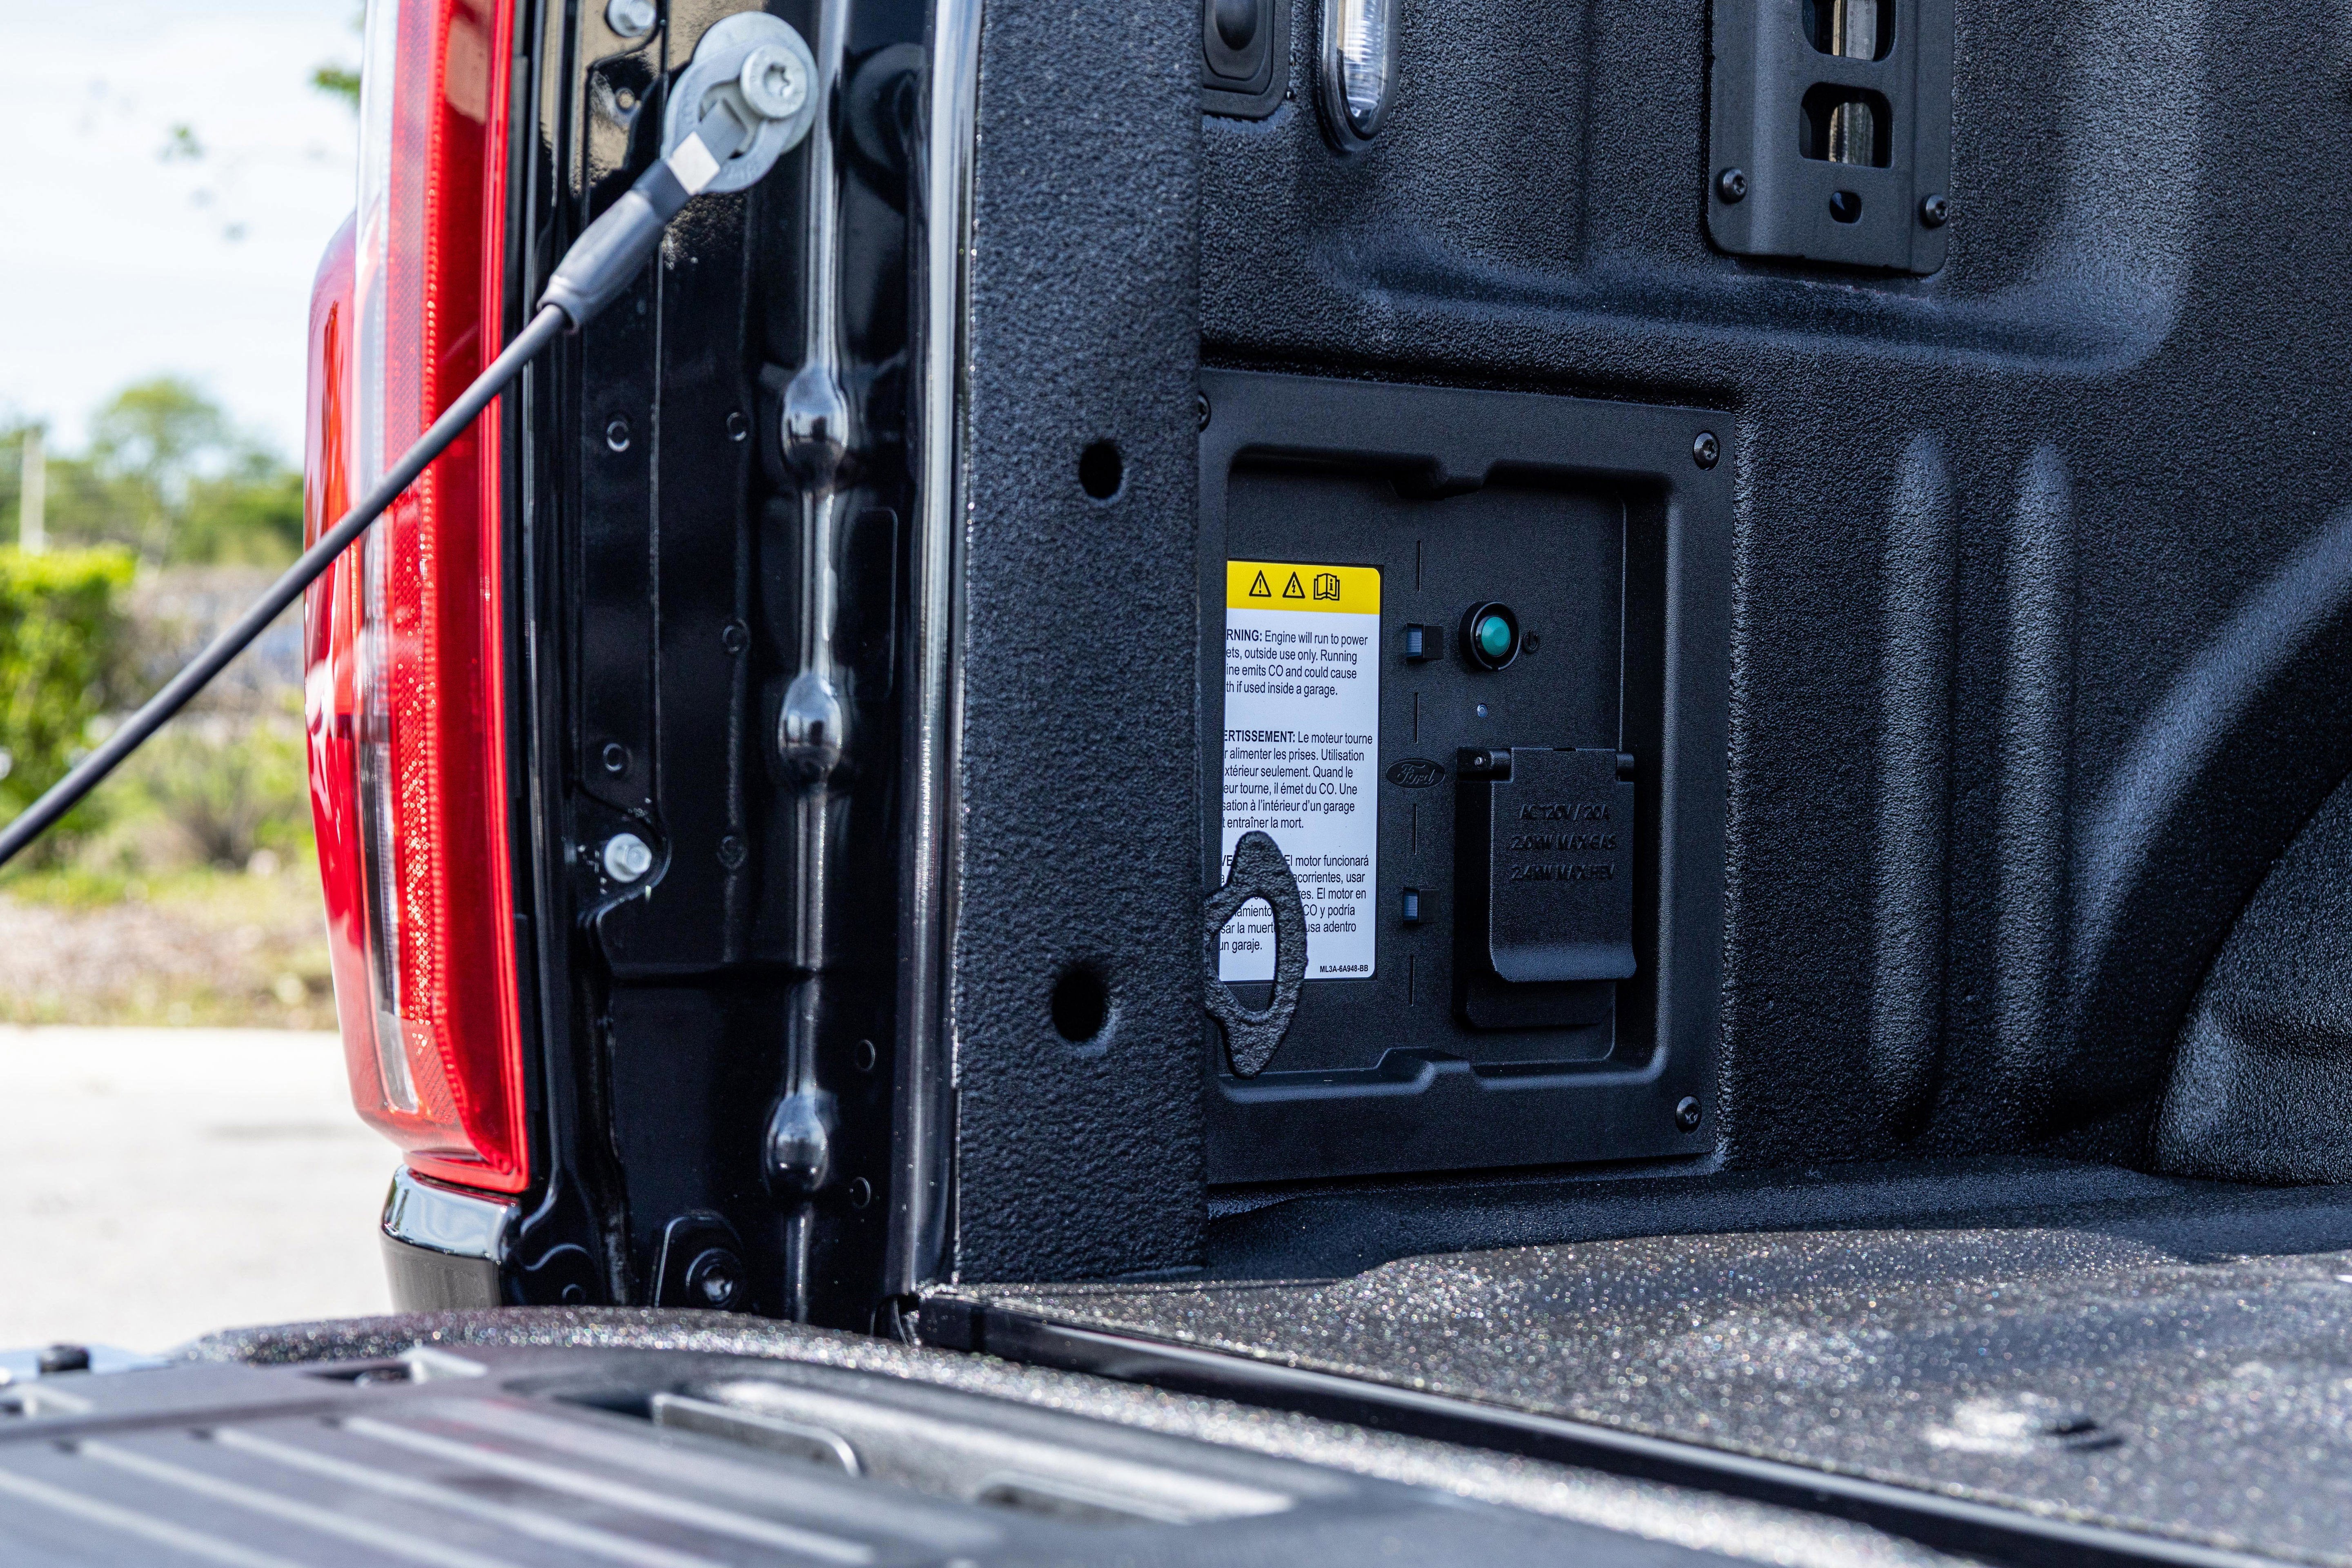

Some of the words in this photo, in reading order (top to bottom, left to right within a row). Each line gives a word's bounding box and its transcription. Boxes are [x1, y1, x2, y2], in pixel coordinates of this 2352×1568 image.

[1226, 629, 1262, 641] RNING:
[1265, 630, 1296, 646] Engine
[1298, 632, 1312, 644] will
[1314, 635, 1328, 644] run
[1331, 633, 1339, 645] to
[1341, 636, 1368, 648] power
[1226, 646, 1242, 660] ets,
[1244, 647, 1277, 659] outside
[1280, 650, 1296, 660] use
[1298, 649, 1318, 664] only.
[1321, 649, 1357, 665] Running
[1227, 663, 1240, 675] ine
[1242, 664, 1266, 676] emits
[1268, 664, 1283, 677] CO
[1285, 666, 1302, 677] and
[1304, 666, 1328, 678] could
[1330, 669, 1357, 679] cause
[1237, 681, 1243, 693] if
[1244, 682, 1265, 693] used
[1268, 682, 1294, 694] inside
[1296, 685, 1301, 695] a
[1304, 686, 1338, 698] garage.
[1225, 729, 1295, 743] ERTISSEMENT:
[1298, 731, 1309, 743] Le
[1311, 732, 1343, 744] moteur
[1345, 733, 1373, 744] tourne
[1229, 747, 1272, 760] alimenter
[1274, 748, 1286, 760] les
[1289, 748, 1318, 763] prises.
[1321, 748, 1364, 761] Utilisation
[1225, 764, 1259, 777] xtérieur
[1261, 765, 1311, 778] seulement.
[1313, 766, 1343, 778] Quand
[1345, 766, 1353, 778] le
[1397, 763, 1437, 784] Ford
[1223, 783, 1238, 794] eur
[1240, 782, 1271, 796] tourne,
[1274, 782, 1278, 794] il
[1281, 782, 1304, 794] émet
[1305, 782, 1316, 795] du
[1319, 782, 1337, 795] CO.
[1339, 783, 1357, 795] Une
[1223, 799, 1248, 811] sation
[1250, 799, 1256, 811] à
[1323, 802, 1355, 815] garage
[1519, 804, 1538, 820] AC
[1584, 804, 1610, 820] 20A
[1227, 816, 1269, 828] entraîner
[1271, 816, 1278, 829] la
[1281, 817, 1304, 829] mort.
[1556, 834, 1587, 850] MAX
[1296, 855, 1321, 866] motor
[1323, 854, 1369, 866] funcionará
[1293, 871, 1343, 884] acorrientes,
[1346, 873, 1365, 883] usar
[1556, 864, 1587, 880] MAX
[1317, 887, 1325, 899] El
[1328, 888, 1354, 899] motor
[1356, 890, 1366, 899] en
[1235, 905, 1273, 917] amiento
[1303, 904, 1317, 916] CO
[1320, 907, 1325, 919] y
[1327, 904, 1355, 918] podría
[1221, 922, 1235, 934] sar
[1237, 922, 1245, 933] la
[1323, 920, 1356, 933] adentro
[1232, 938, 1262, 953] garaje.
[1320, 964, 1368, 973] ML3A-6A948-BB
